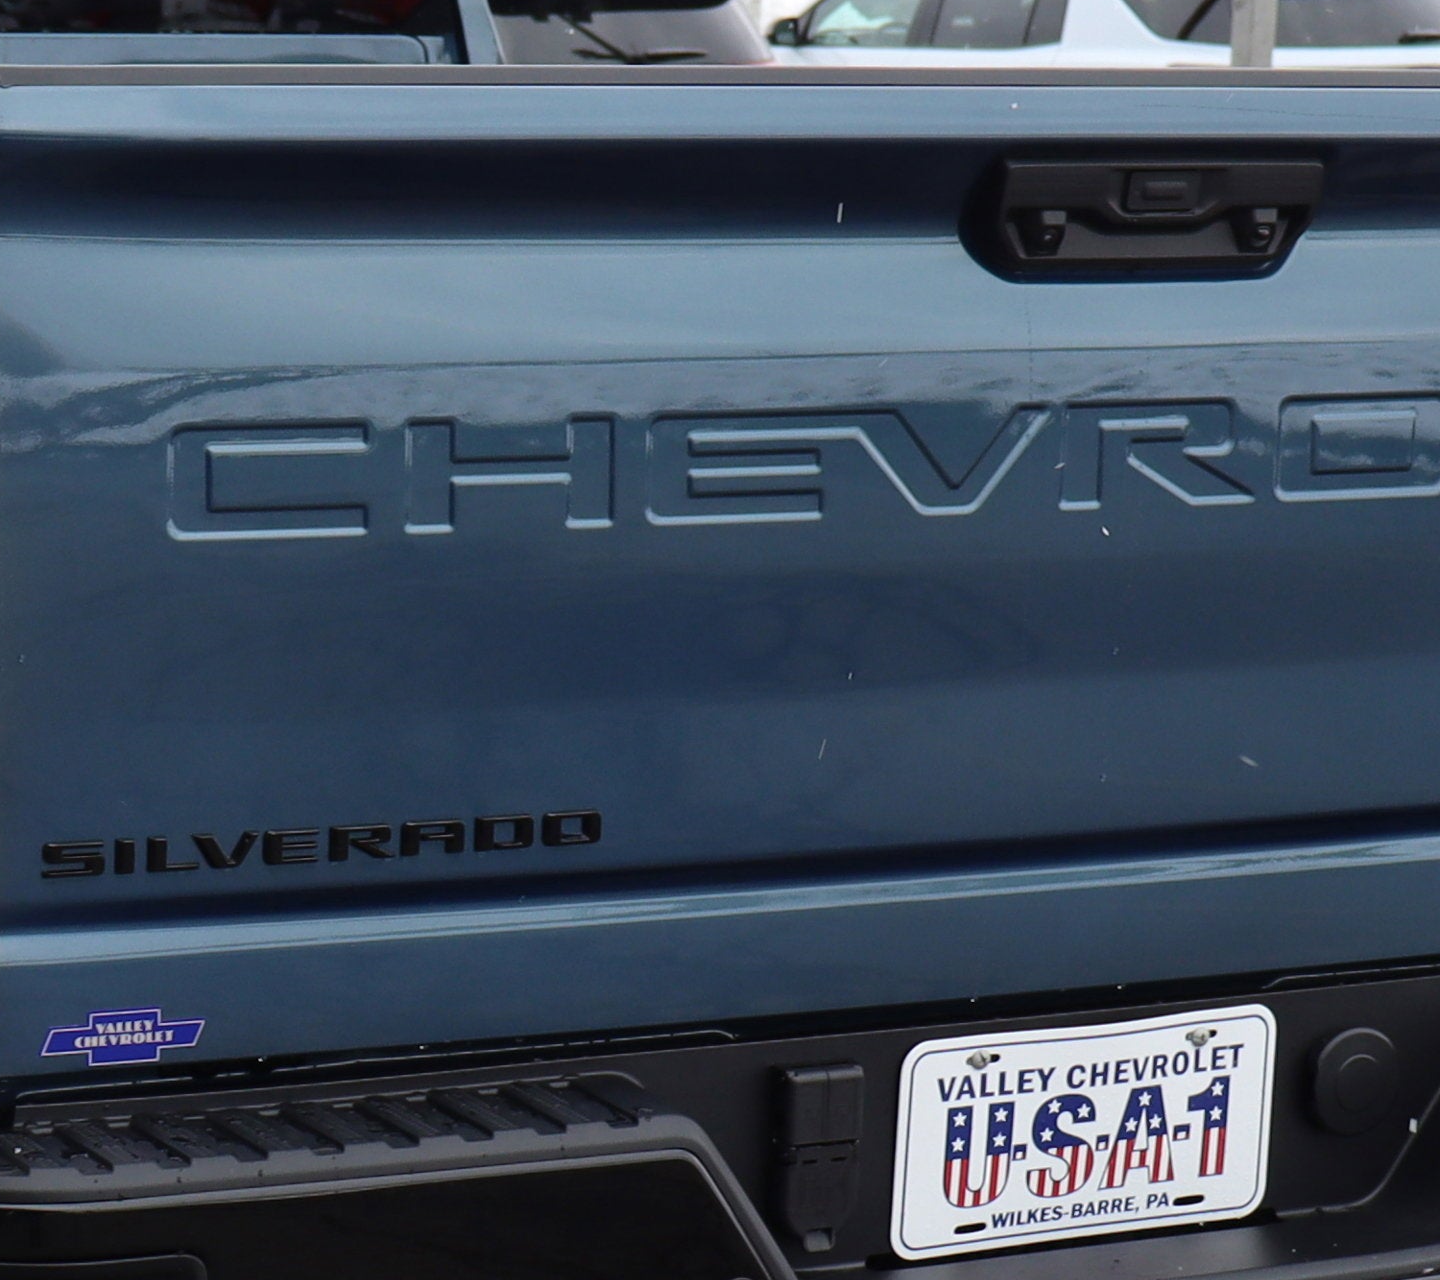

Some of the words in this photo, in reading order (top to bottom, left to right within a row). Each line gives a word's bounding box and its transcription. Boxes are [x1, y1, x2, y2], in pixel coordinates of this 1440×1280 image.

[40, 808, 603, 879] SILVERADO
[73, 1030, 175, 1049] CHEVROLET
[94, 1019, 156, 1035] VALLEY
[937, 1066, 1056, 1103] VALLEY
[1066, 1043, 1245, 1089] CHEVROLET
[991, 1197, 1140, 1229] WILKES-BARRE,
[1146, 1193, 1169, 1211] PA
